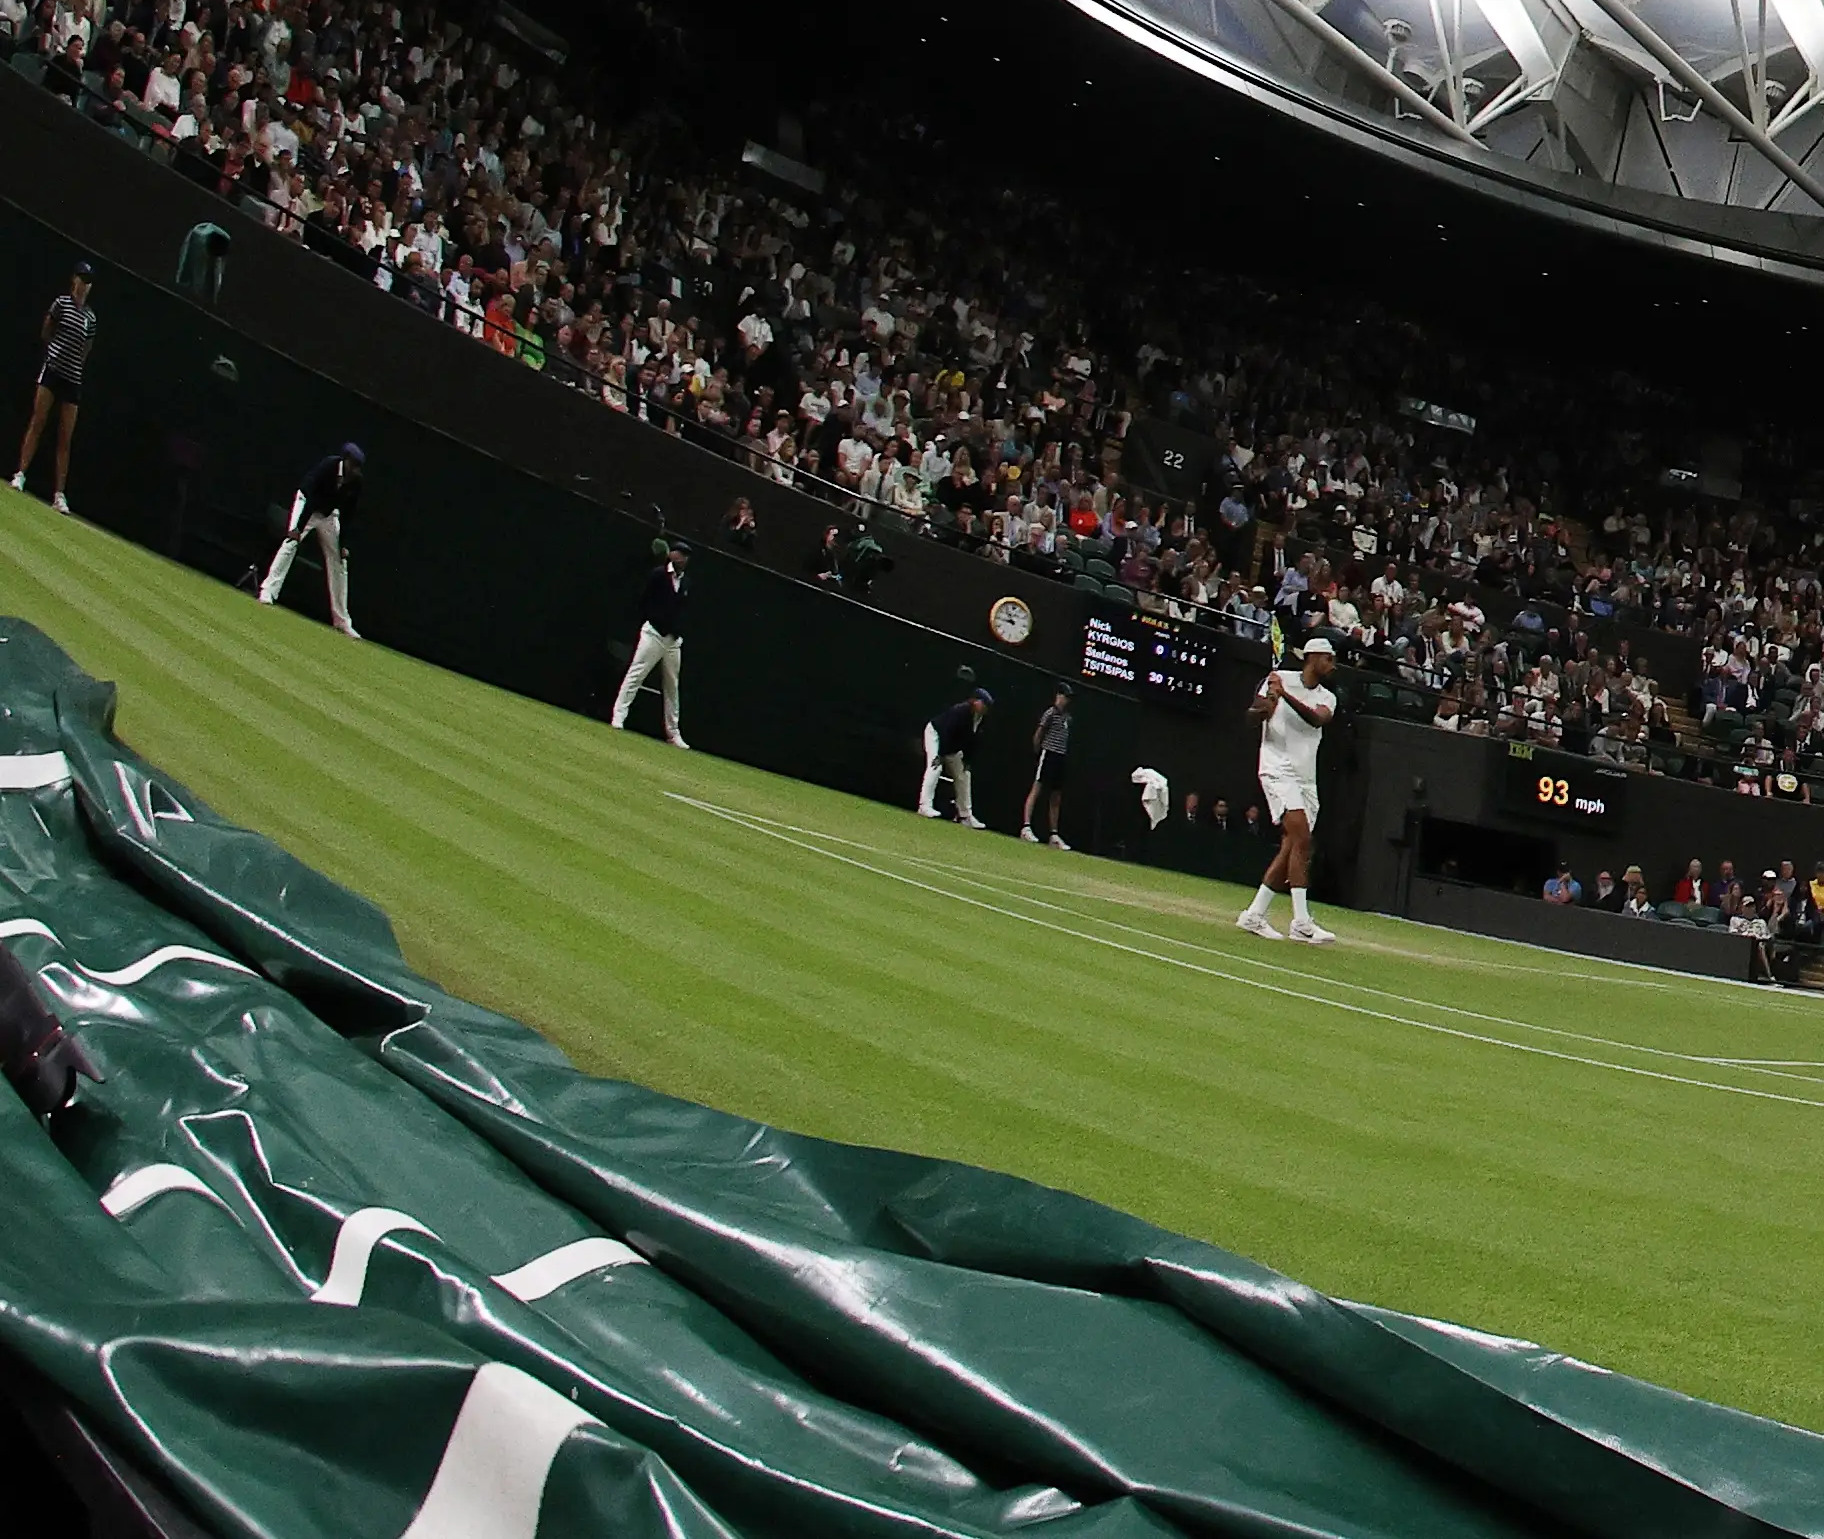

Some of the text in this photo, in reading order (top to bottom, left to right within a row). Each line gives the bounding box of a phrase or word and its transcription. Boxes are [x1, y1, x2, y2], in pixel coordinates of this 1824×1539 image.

[1163, 450, 1184, 469] 22
[1089, 617, 1112, 633] Nick
[1087, 629, 1135, 652] KYRGIOS
[1155, 644, 1165, 655] 0
[1085, 646, 1129, 667] Stefanos
[1083, 658, 1135, 681] TSITSIPAS
[1149, 671, 1164, 684] 30
[1508, 742, 1534, 761] IBM
[1538, 776, 1605, 814] 93 mph
